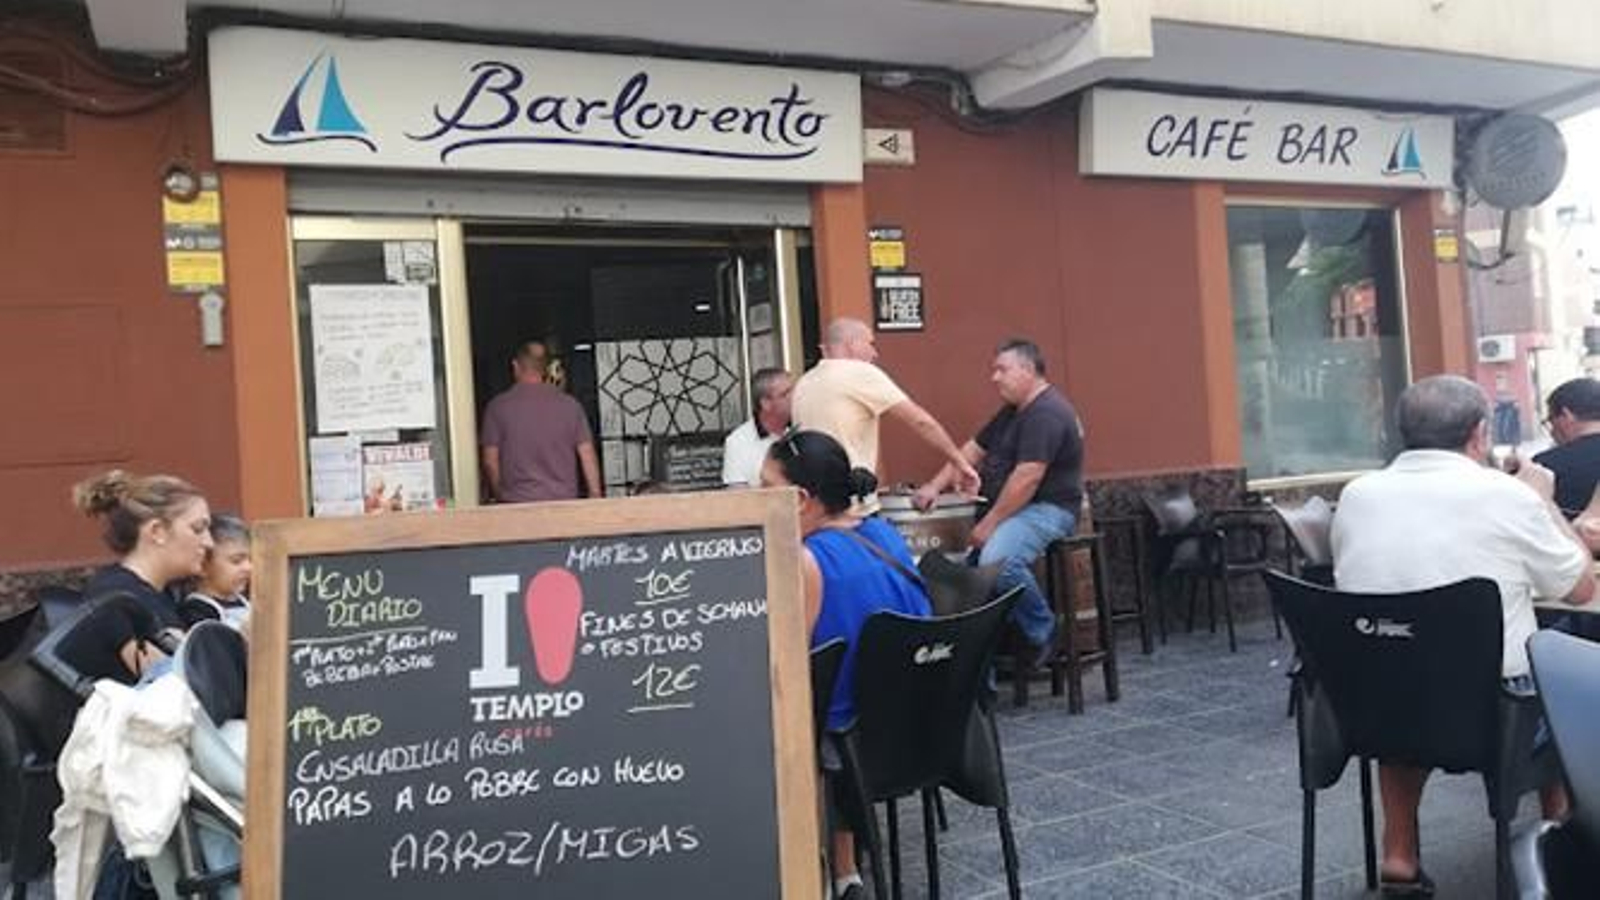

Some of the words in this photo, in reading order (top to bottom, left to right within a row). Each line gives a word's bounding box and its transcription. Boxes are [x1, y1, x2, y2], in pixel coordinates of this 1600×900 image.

[402, 61, 827, 147] Barlovento
[1147, 105, 1254, 161] CAFÉ
[1277, 123, 1358, 166] BAR
[661, 541, 678, 562] A
[297, 565, 384, 602] MENU
[635, 569, 695, 598] 10€
[327, 596, 422, 627] DIARIO
[579, 610, 655, 637] FINES
[661, 608, 692, 630] DE
[600, 631, 703, 658] FESTIVOS
[632, 662, 701, 699] 12€
[470, 691, 585, 722] TEMPLO
[296, 738, 459, 783] ENSALADILLA
[468, 731, 524, 760] RUSA
[288, 786, 371, 825] PAPAS
[395, 786, 415, 813] A
[464, 766, 540, 800] POBRE
[553, 767, 601, 787] CON
